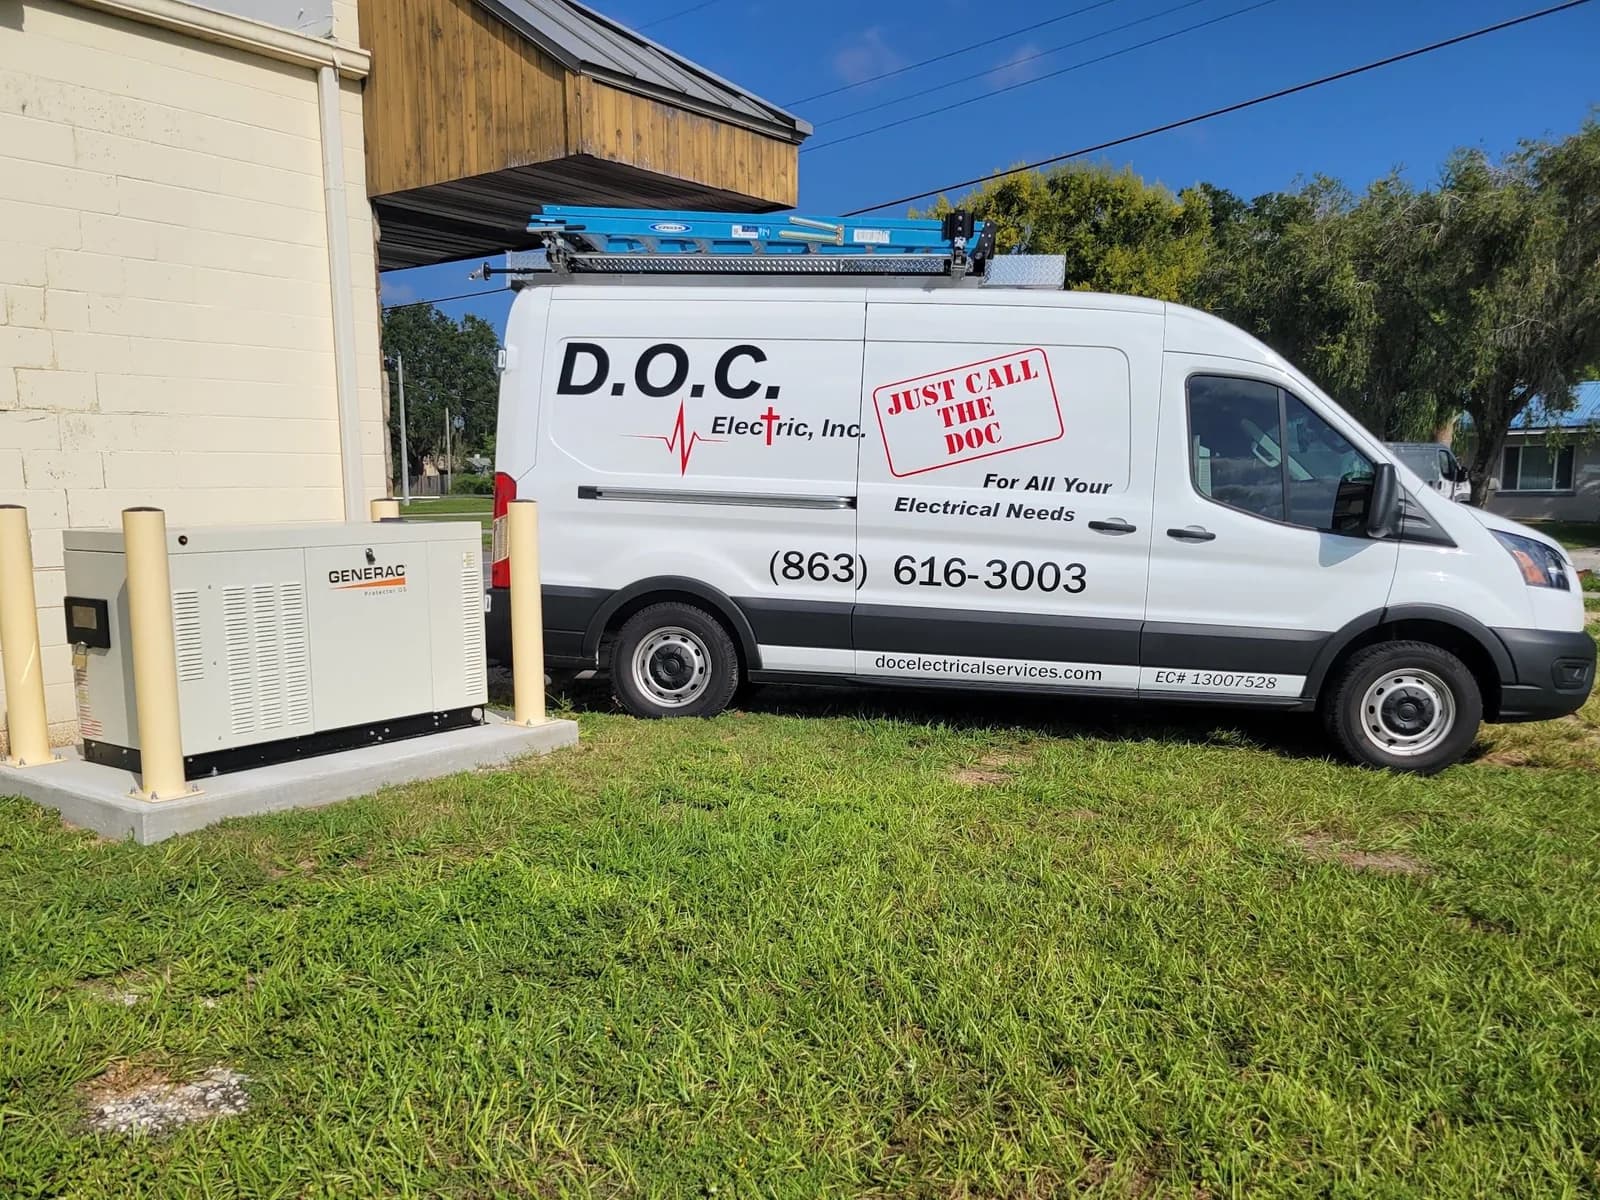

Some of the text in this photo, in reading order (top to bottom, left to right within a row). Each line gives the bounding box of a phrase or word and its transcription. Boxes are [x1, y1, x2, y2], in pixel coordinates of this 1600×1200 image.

[556, 342, 781, 400] D.O.C.
[888, 359, 1039, 416] JUST CALL
[711, 406, 867, 446] Electric, Inc.
[937, 396, 995, 428] THE
[944, 422, 1002, 455] DOC
[983, 473, 1113, 495] For All Your
[893, 496, 1076, 522] Electrical Needs
[328, 564, 406, 584] GENERAC
[769, 549, 1087, 594] (863) 616-3003
[875, 654, 1103, 681] docelectricalservices.com
[1155, 670, 1278, 690] EC# 13007528
